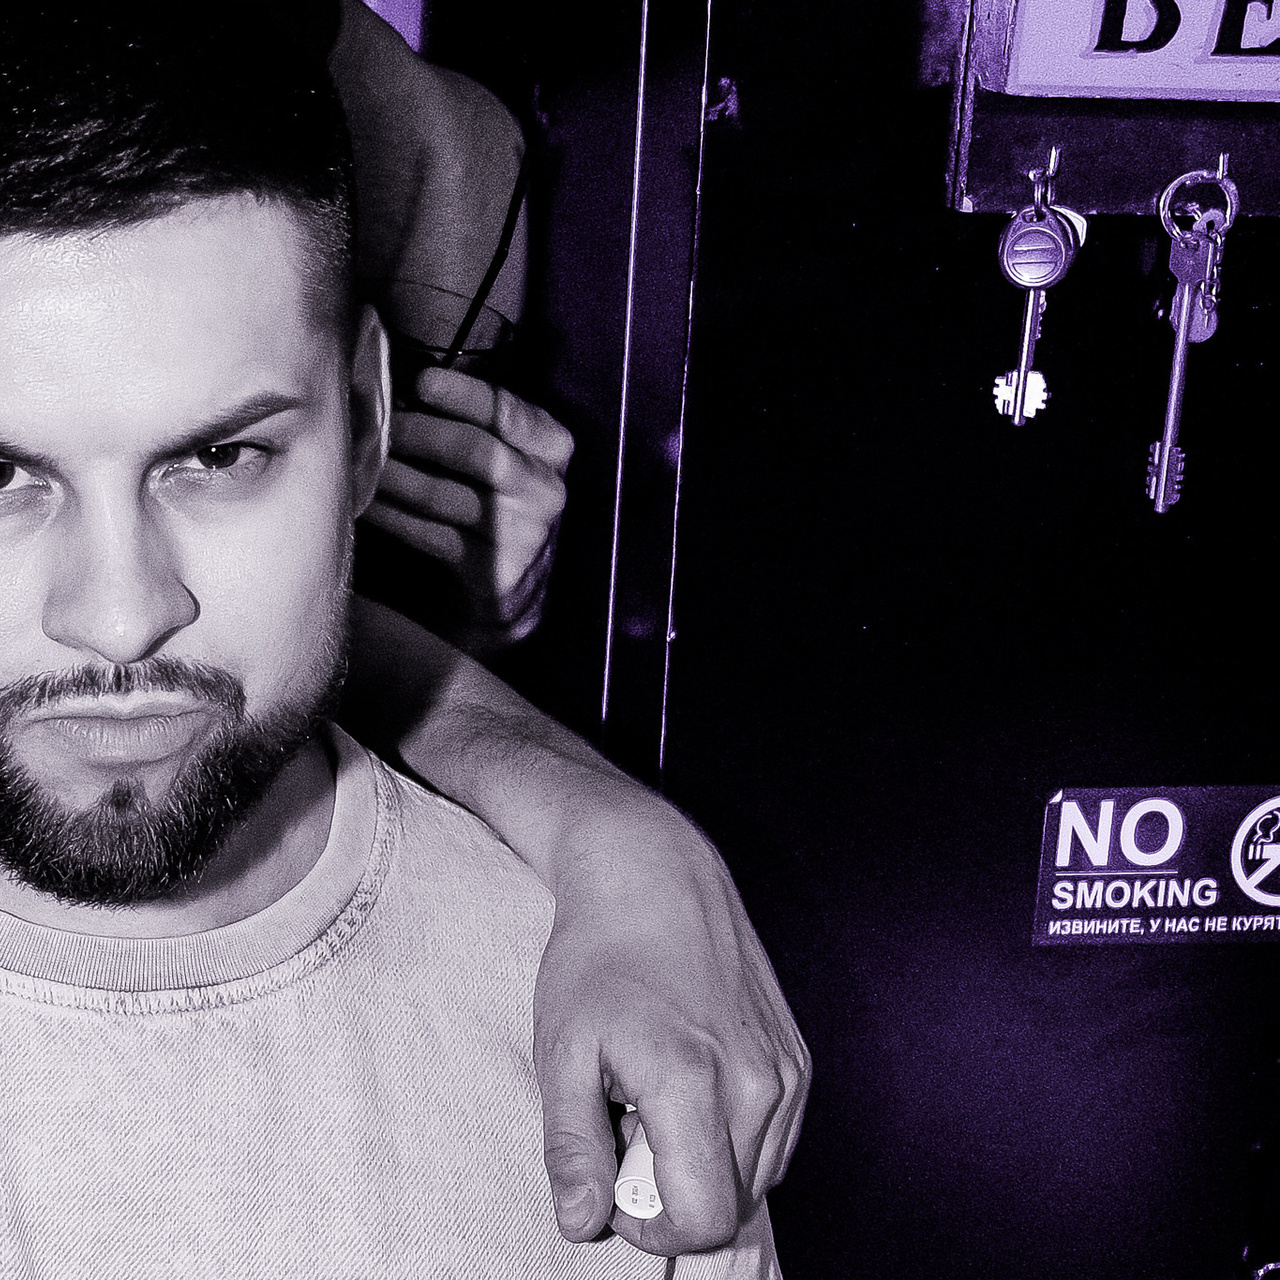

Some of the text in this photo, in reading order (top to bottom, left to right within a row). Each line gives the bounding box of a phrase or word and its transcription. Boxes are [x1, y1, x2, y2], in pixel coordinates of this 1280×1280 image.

[1055, 797, 1184, 868] NO
[1051, 879, 1218, 910] SMOKING
[1049, 918, 1145, 936] ИЗВИНИТЕ,
[1150, 919, 1162, 934] У
[1164, 918, 1200, 934] НАС
[1205, 917, 1228, 933] НЕ
